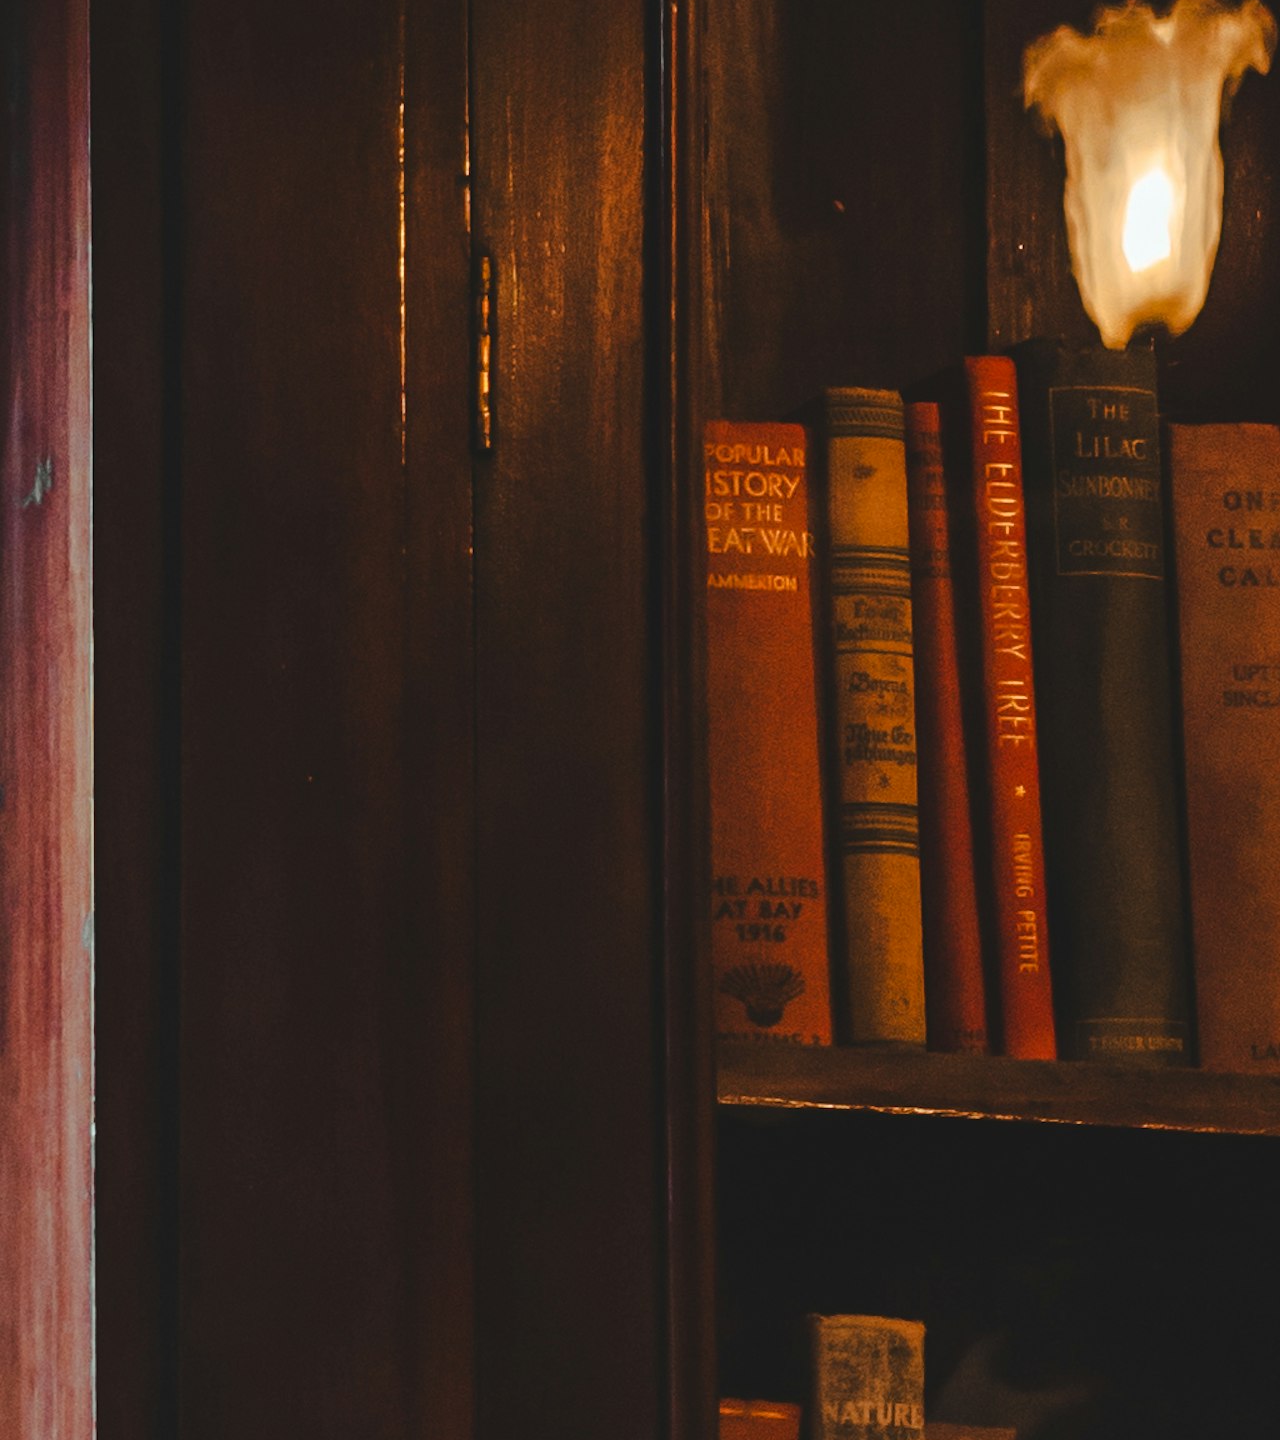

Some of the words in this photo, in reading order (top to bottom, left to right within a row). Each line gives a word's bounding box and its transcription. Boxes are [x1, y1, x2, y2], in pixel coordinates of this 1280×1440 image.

[982, 388, 1018, 445] THE
[1085, 397, 1131, 422] THE
[704, 442, 806, 468] POPULAR
[1075, 431, 1149, 461] LILAC
[705, 469, 801, 499] ISTORY
[704, 502, 735, 522] OF
[741, 502, 784, 523] THE
[758, 526, 816, 559] WAR
[1068, 539, 1161, 561] CROCKETT
[984, 461, 1030, 662] ELDERBERRY
[996, 678, 1033, 750] TREE
[1012, 831, 1035, 899] IRVING
[746, 876, 819, 899] ALLIES
[715, 900, 748, 921] AT
[759, 901, 804, 920] BAY
[736, 923, 787, 943] 1916
[1018, 908, 1041, 974] PETITE
[822, 1401, 926, 1431] NATURE
